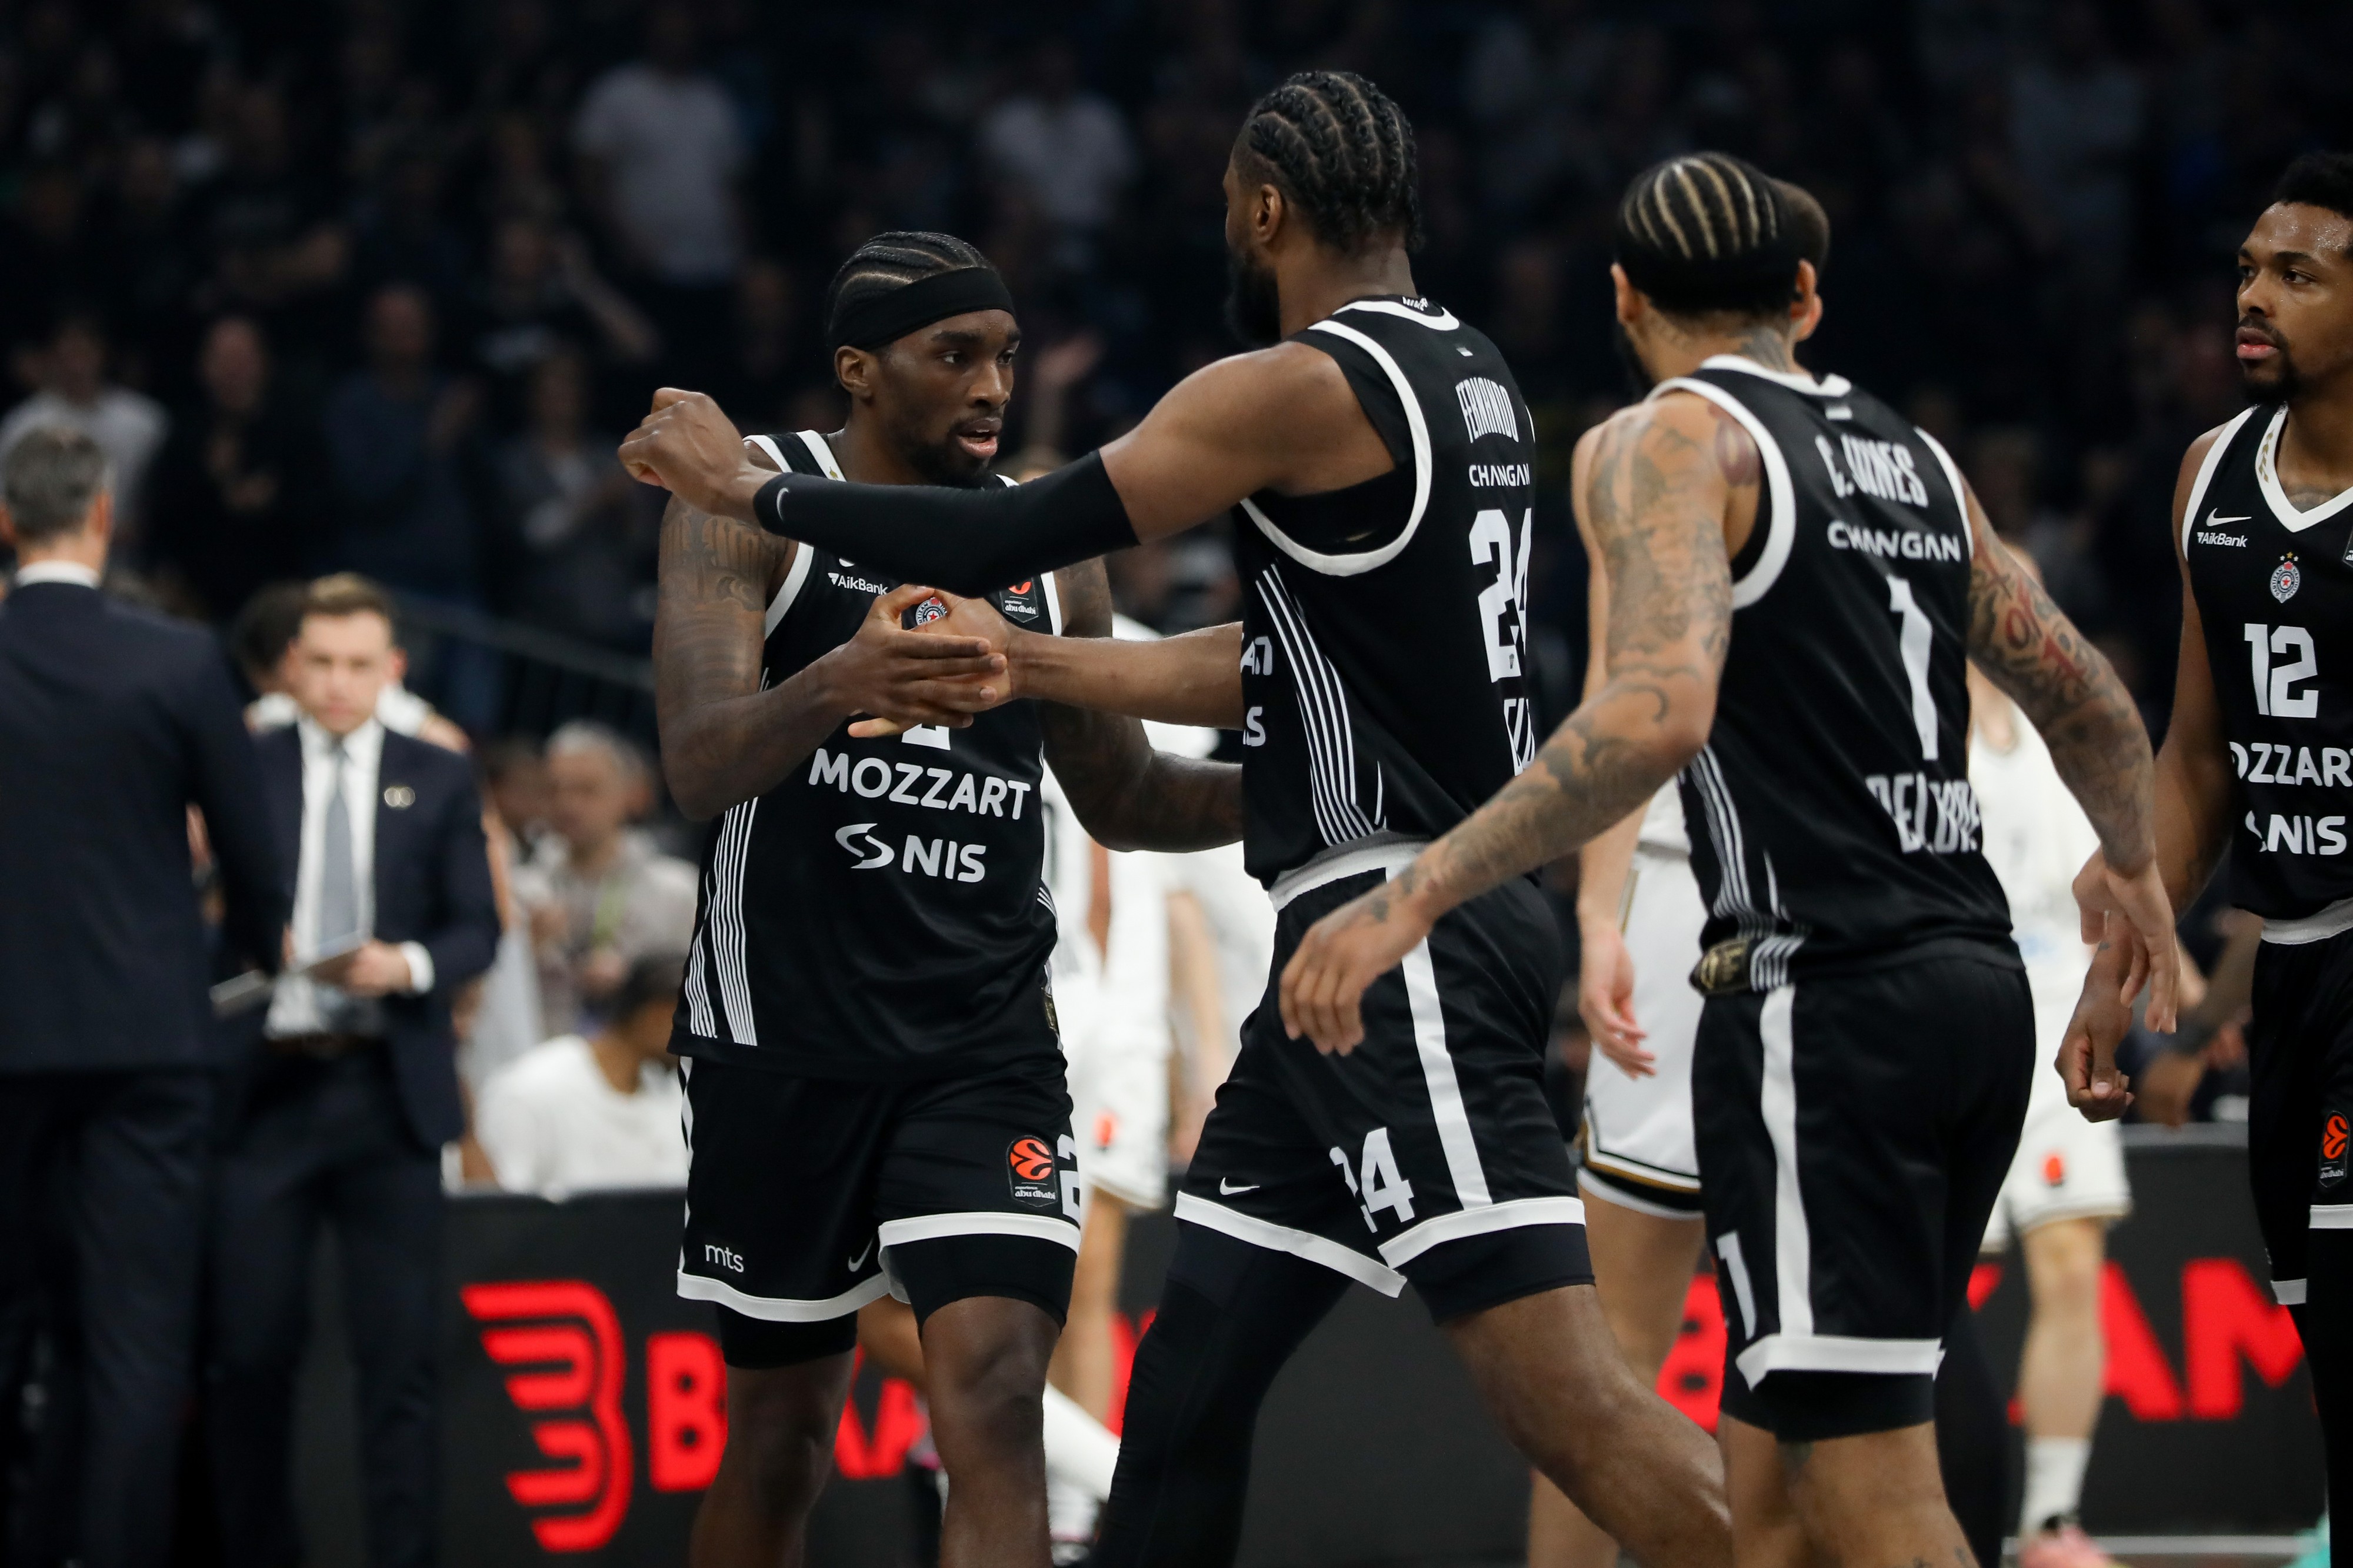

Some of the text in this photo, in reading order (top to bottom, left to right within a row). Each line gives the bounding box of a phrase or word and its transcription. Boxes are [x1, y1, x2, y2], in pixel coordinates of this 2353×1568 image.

[1469, 463, 1530, 487] CHANGAN
[2201, 532, 2248, 548] AikBank
[838, 575, 889, 595] AikBank
[1886, 573, 1939, 760] 1
[2244, 623, 2319, 719] 12
[809, 748, 1031, 820] MOZZART
[2268, 814, 2348, 856] NIS
[902, 834, 987, 883] NIS
[1015, 1189, 1056, 1199] abu dhabi
[705, 1244, 745, 1273] mts
[1718, 1231, 1757, 1340] 1
